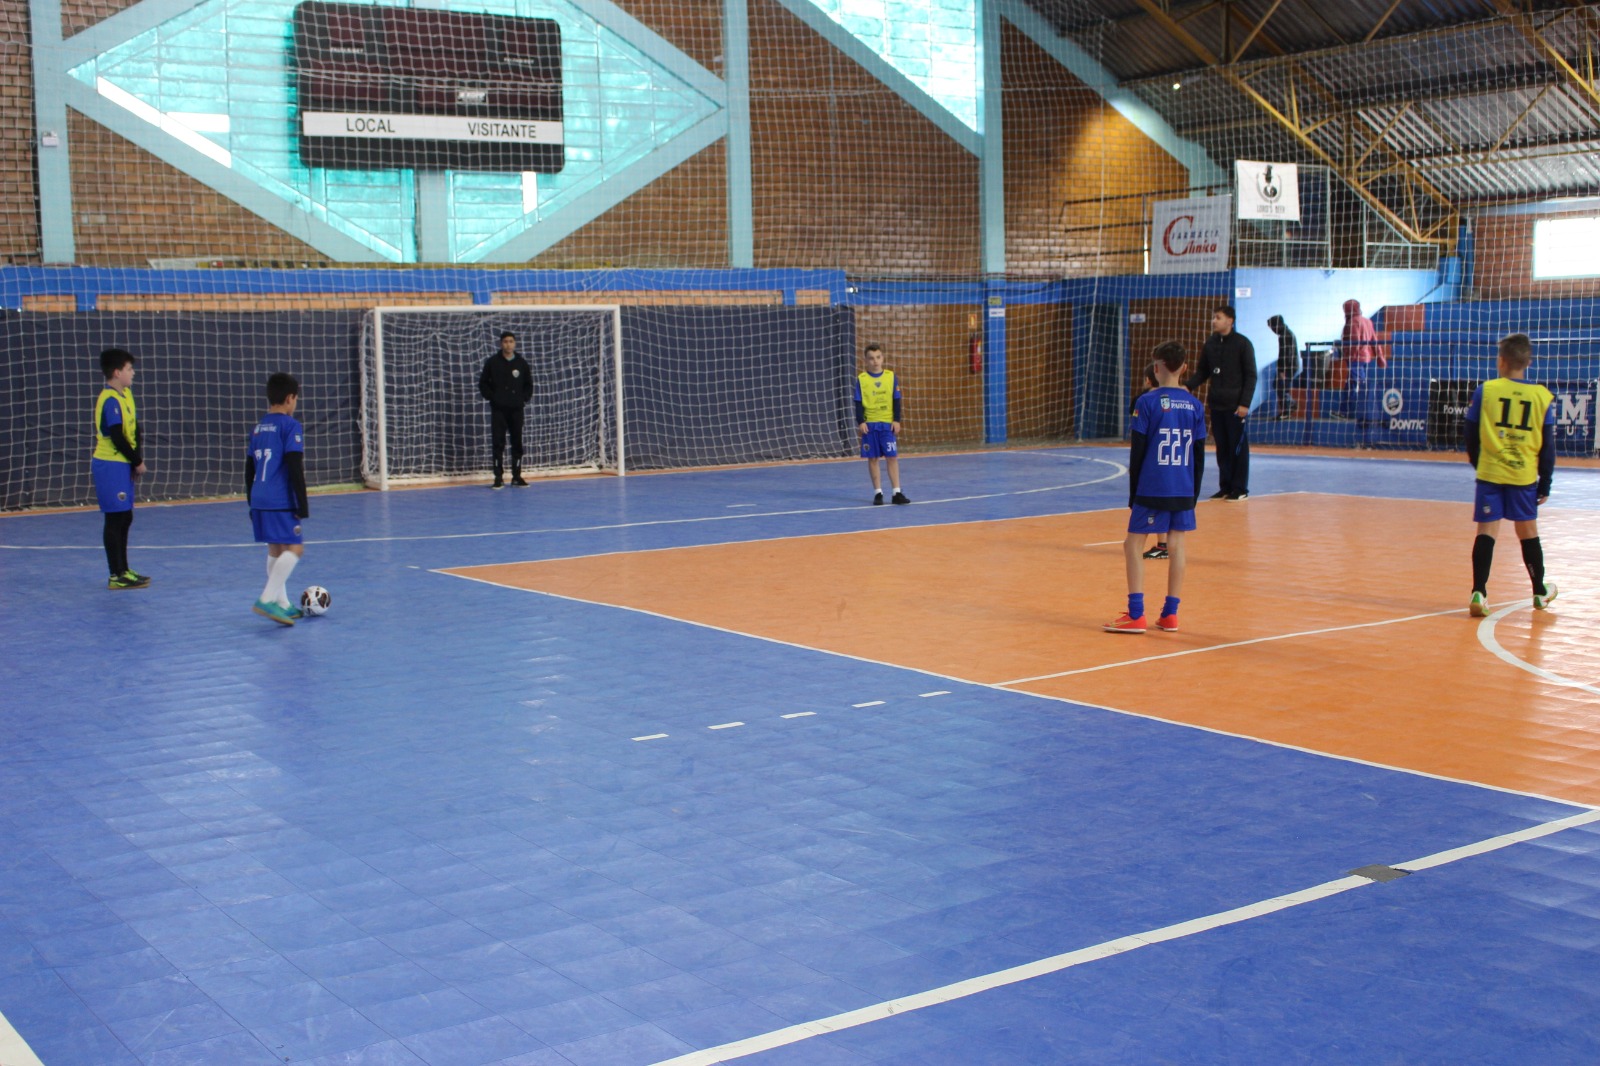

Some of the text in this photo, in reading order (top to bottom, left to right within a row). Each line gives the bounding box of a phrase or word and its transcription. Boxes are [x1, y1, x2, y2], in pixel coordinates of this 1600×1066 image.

[346, 118, 537, 138] LOCAL VISITANTE
[1390, 418, 1425, 431] DONTIC
[1495, 397, 1533, 431] 11
[1158, 427, 1192, 467] 227
